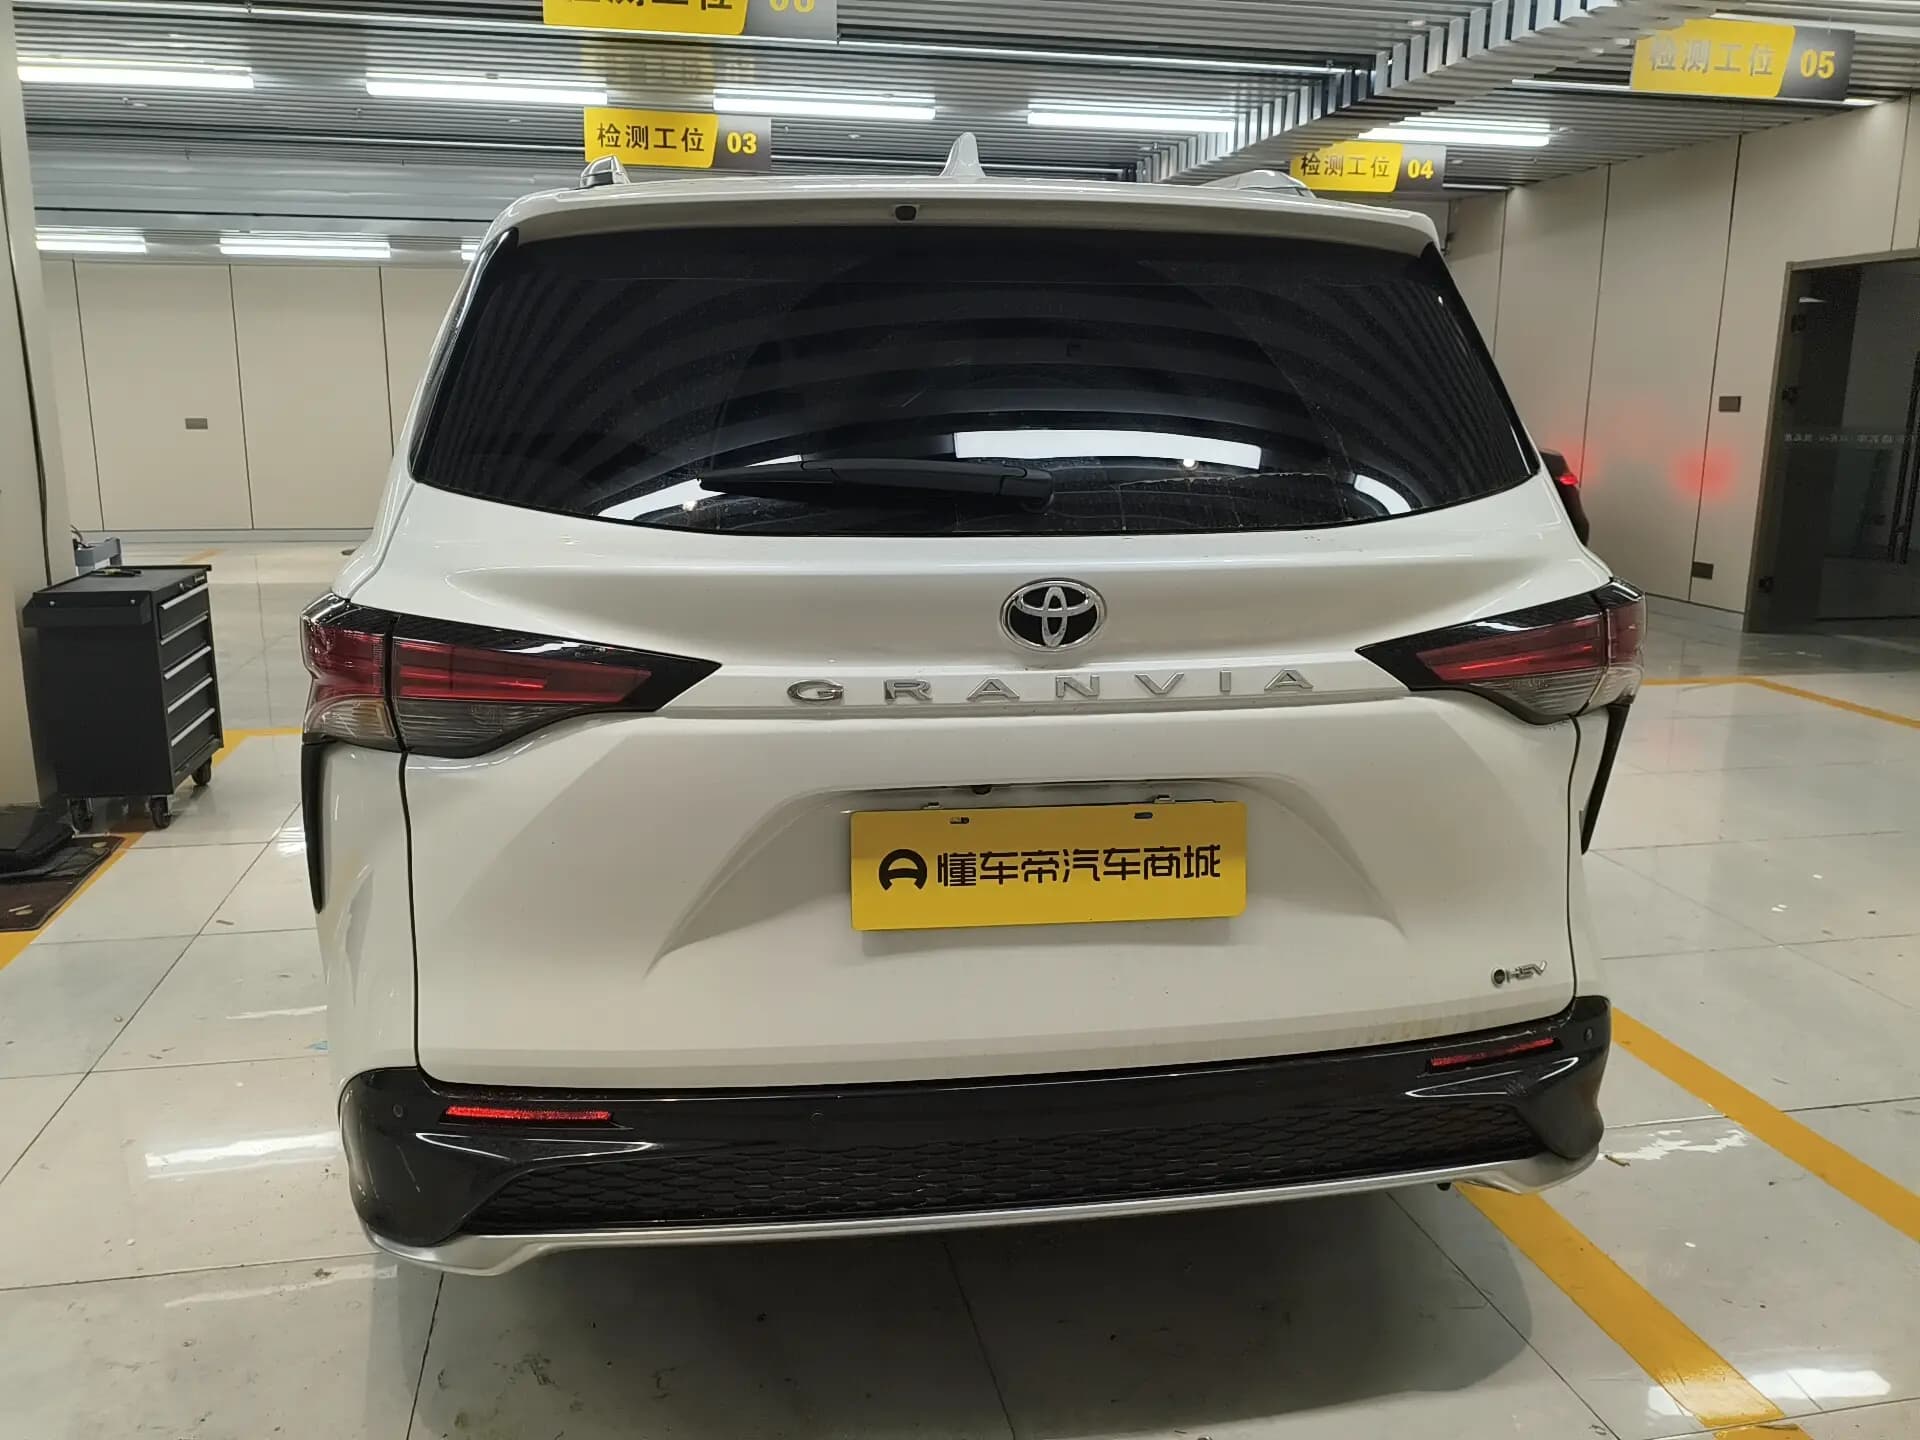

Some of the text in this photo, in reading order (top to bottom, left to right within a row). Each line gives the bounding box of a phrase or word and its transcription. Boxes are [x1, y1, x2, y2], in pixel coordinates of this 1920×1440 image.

[1651, 37, 1836, 79] 检测工位 05
[597, 122, 757, 154] 检测工位 03
[1300, 152, 1434, 179] 检测工位 04
[787, 668, 1314, 701] GRANVIA
[937, 844, 1221, 887] 懂车帝汽车商城
[1505, 960, 1548, 983] HEV
